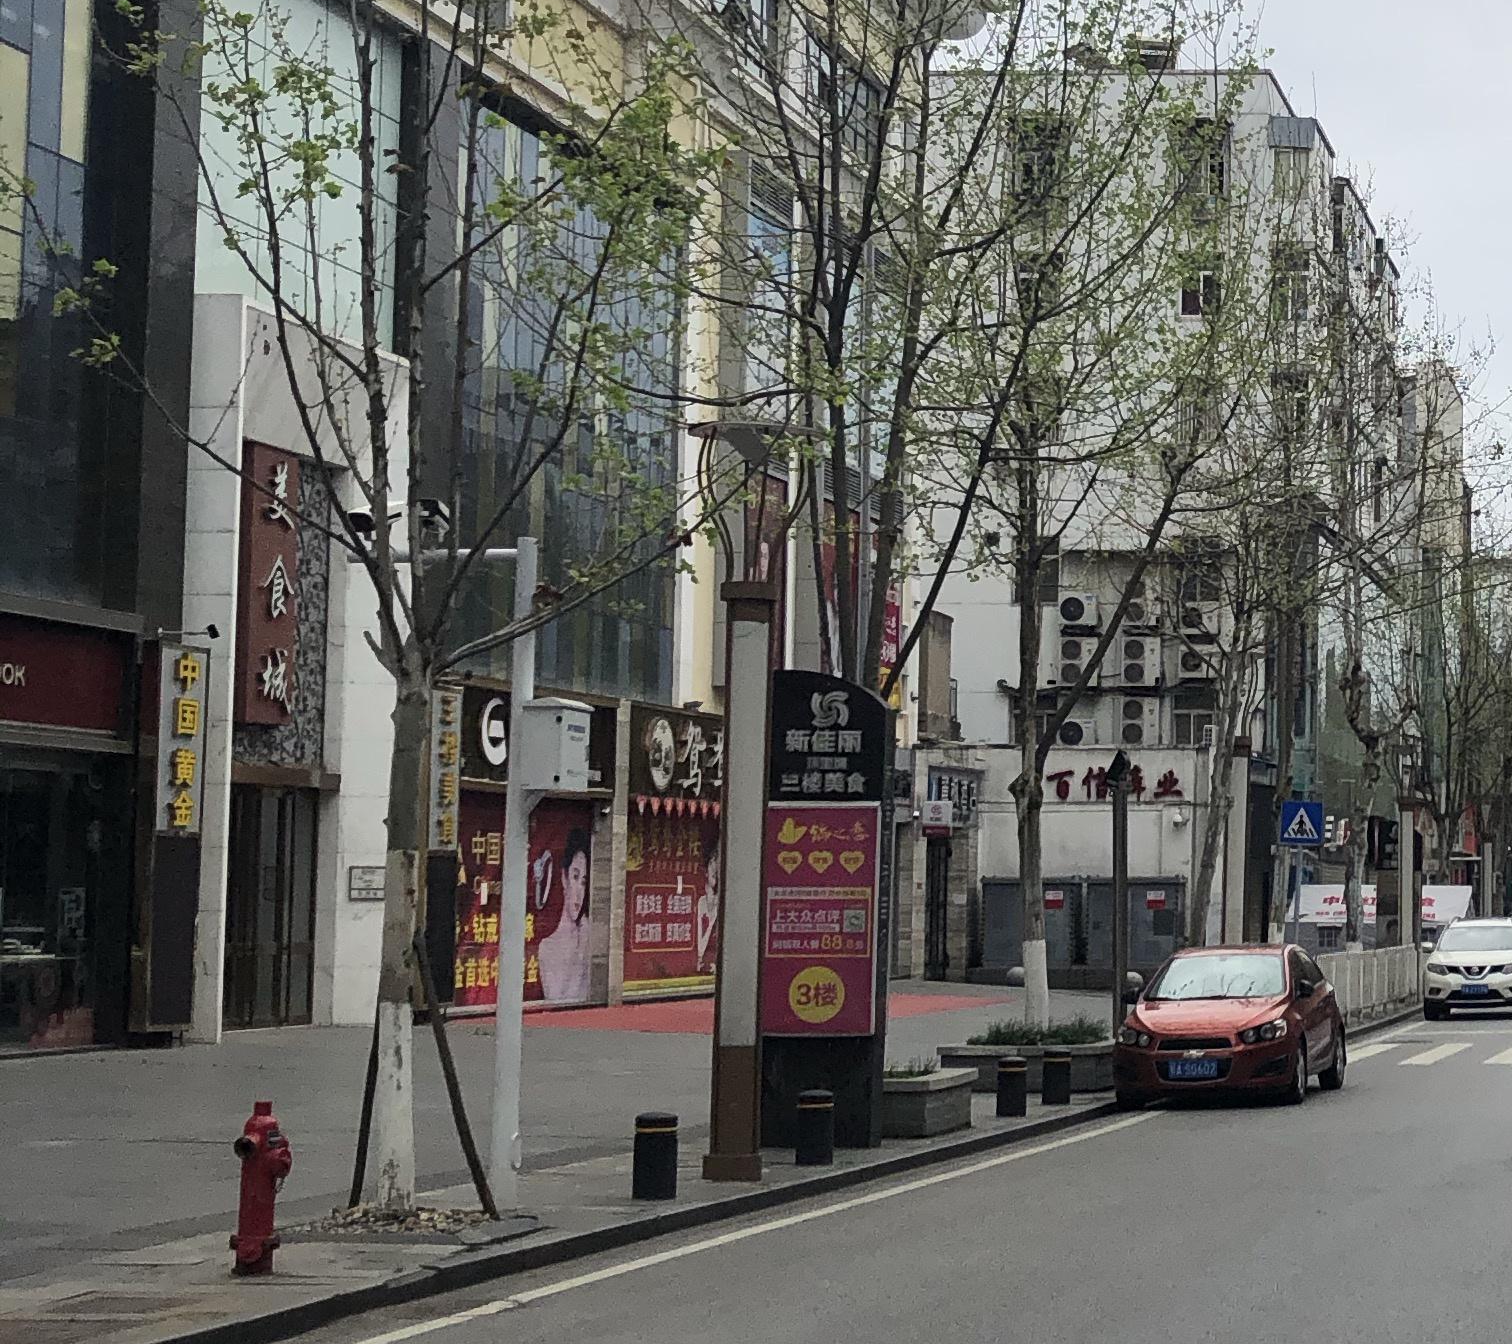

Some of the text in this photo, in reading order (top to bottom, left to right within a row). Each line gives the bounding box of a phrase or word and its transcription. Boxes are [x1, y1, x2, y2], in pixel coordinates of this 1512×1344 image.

[0, 663, 26, 687] OK
[172, 652, 201, 827] 中国黄金
[785, 729, 863, 754] 新佳丽
[779, 771, 867, 794] 三楼美食
[796, 981, 839, 1007] 3楼
